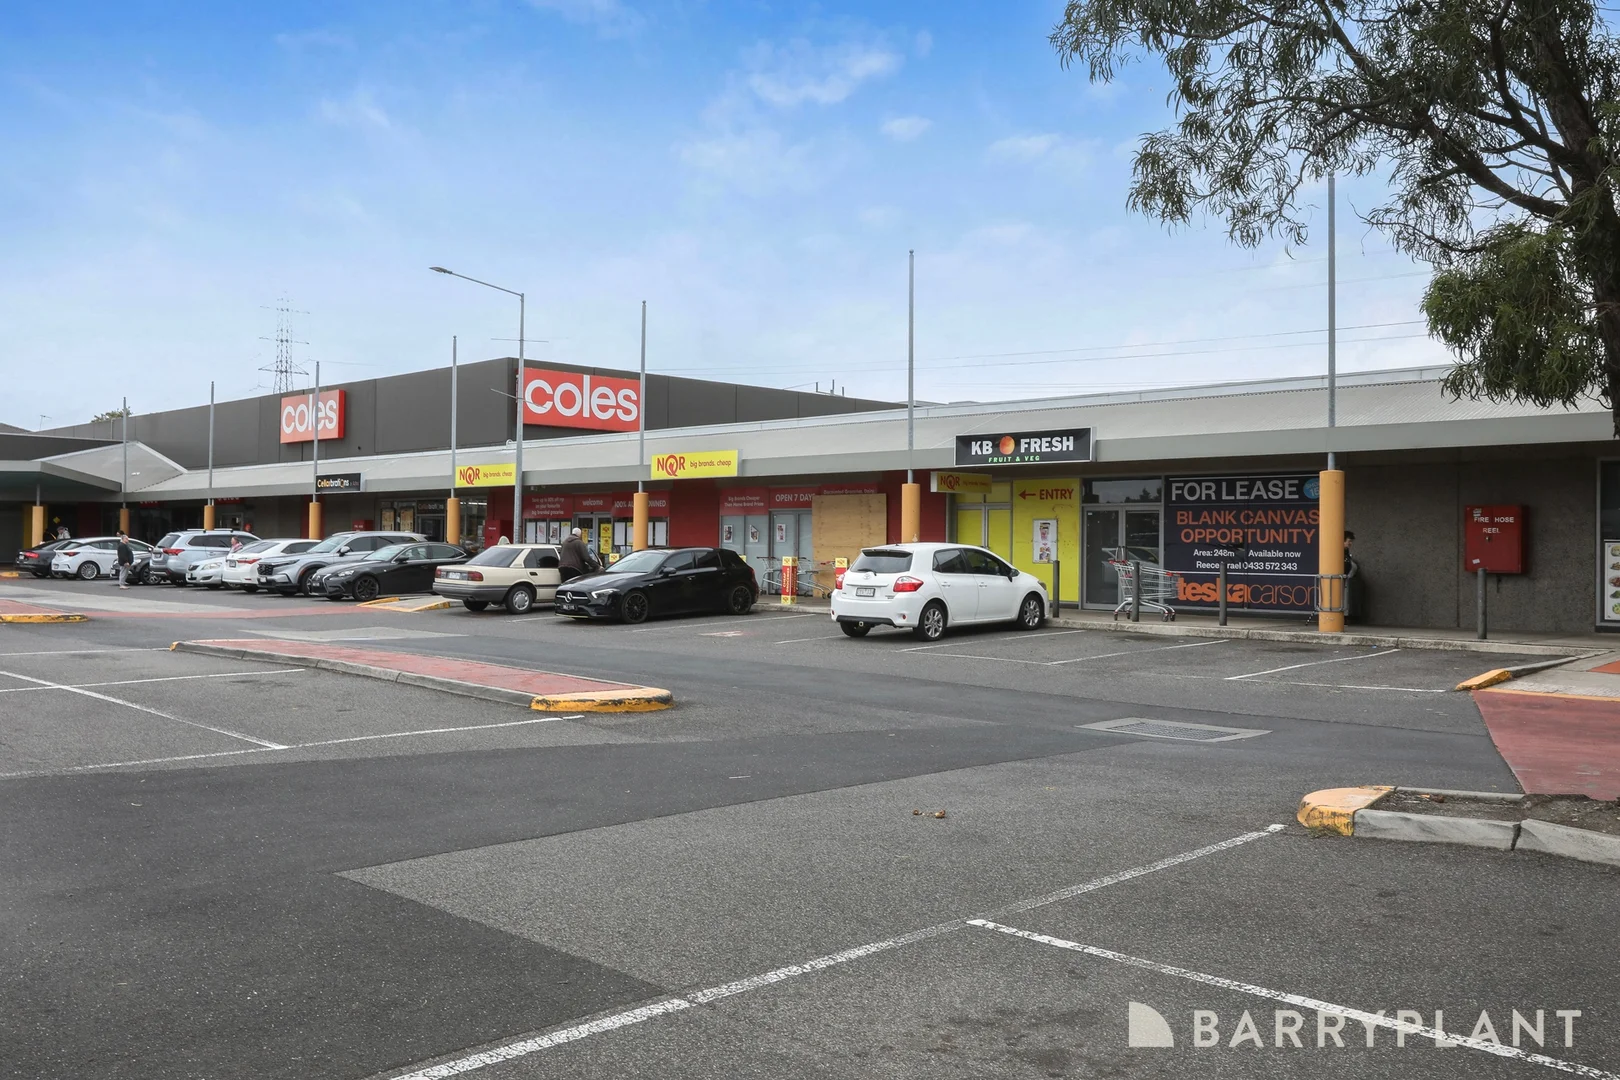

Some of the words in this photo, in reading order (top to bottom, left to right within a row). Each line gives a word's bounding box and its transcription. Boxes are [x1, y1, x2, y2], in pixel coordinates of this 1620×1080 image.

[525, 375, 639, 422] coles
[282, 394, 337, 434] coles
[971, 441, 993, 455] KB
[1020, 436, 1074, 453] FRESH
[657, 454, 686, 476] NQR
[459, 467, 480, 485] NQR
[940, 474, 960, 490] NQR
[775, 494, 793, 502] OPEN
[794, 494, 799, 502] 7
[1039, 489, 1074, 500] ENTRY
[1171, 482, 1216, 501] FOR
[1221, 480, 1299, 500] LEASE
[582, 498, 603, 507] welcome
[1177, 511, 1238, 525] BLANK
[1240, 509, 1320, 525] CANVAS
[1180, 528, 1315, 544] OPPORTUNITY
[1193, 549, 1213, 557] Area:
[1248, 549, 1284, 558] Available
[1196, 561, 1220, 569] Reece
[1242, 562, 1264, 570] 0433
[1265, 562, 1281, 570] 572
[1281, 562, 1298, 570] 343
